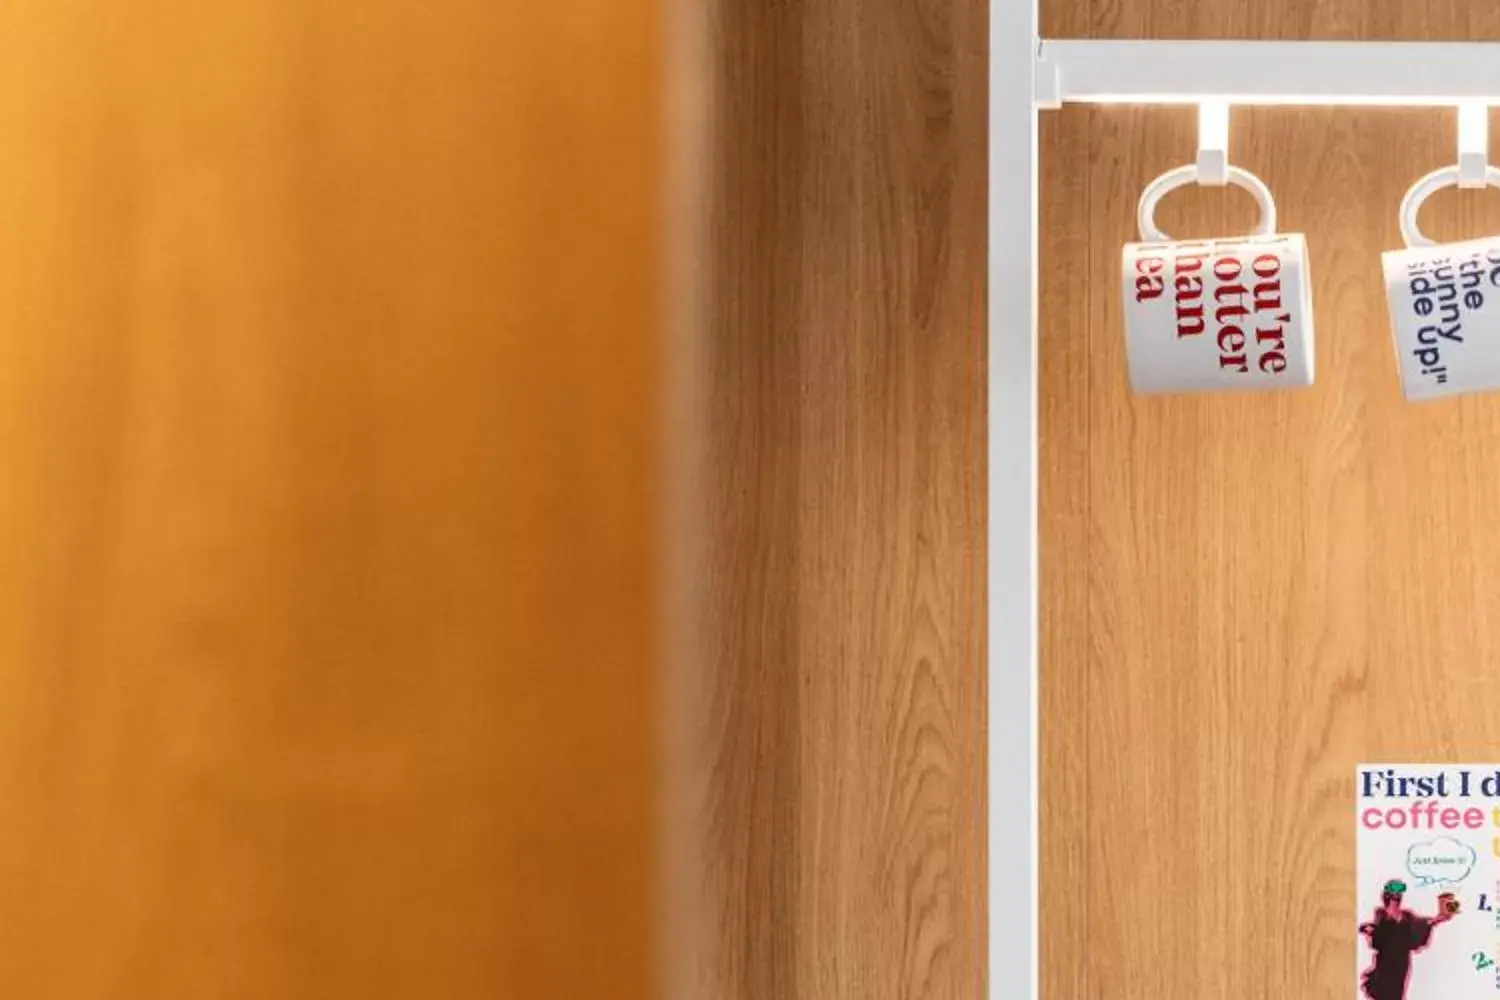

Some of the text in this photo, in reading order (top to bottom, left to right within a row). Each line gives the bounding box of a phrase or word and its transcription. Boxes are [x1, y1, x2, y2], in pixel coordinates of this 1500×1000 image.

[1135, 246, 1165, 303] ea
[1174, 243, 1210, 340] han
[1213, 240, 1250, 373] otter
[1252, 238, 1291, 374] ou're
[1361, 769, 1449, 797] First
[1459, 771, 1471, 797] I
[1361, 800, 1485, 830] coffee
[1477, 893, 1492, 912] 1.
[1472, 951, 1494, 971] 2.
